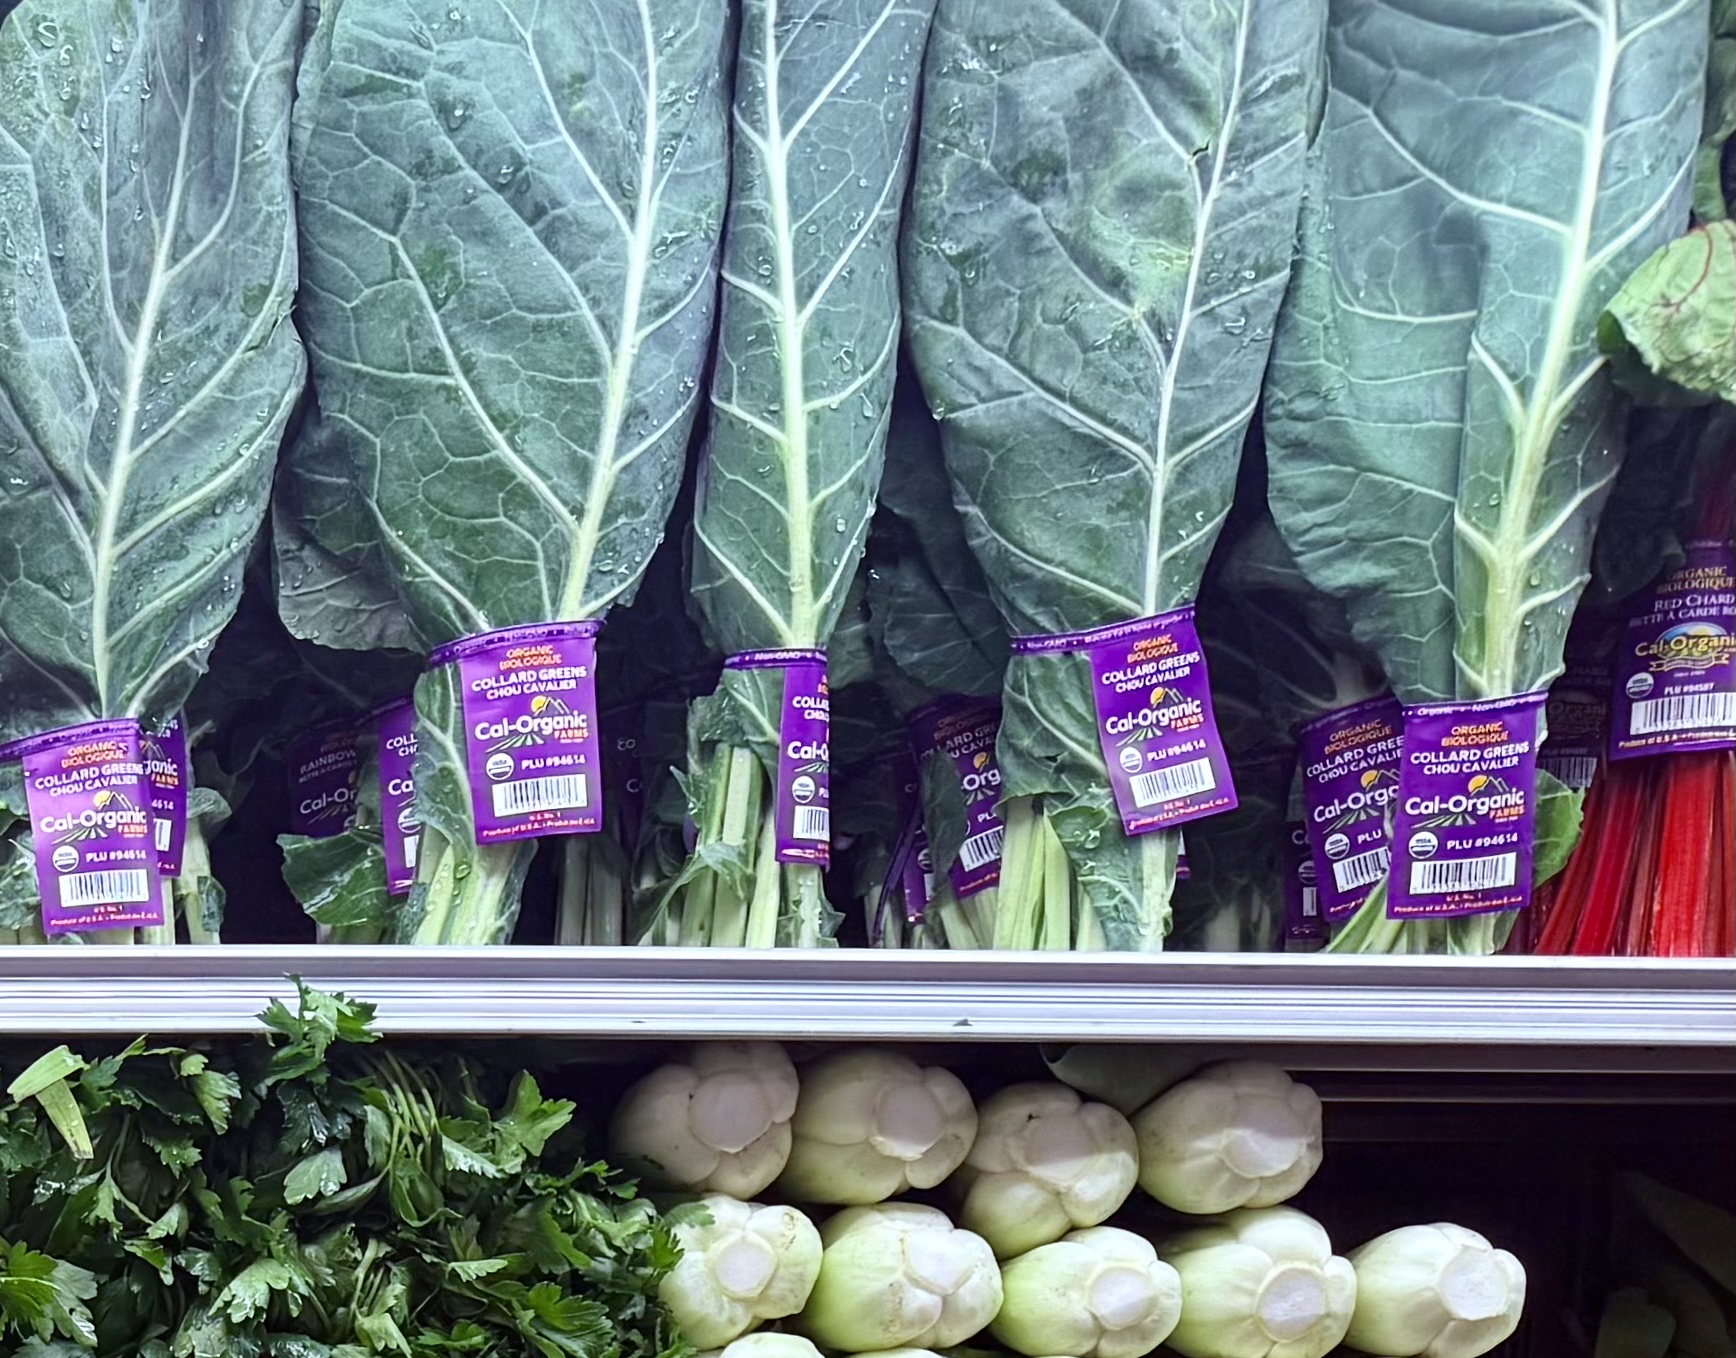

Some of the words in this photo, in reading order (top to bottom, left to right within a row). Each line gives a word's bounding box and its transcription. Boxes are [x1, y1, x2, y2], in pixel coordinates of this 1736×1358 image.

[1654, 599, 1682, 613] RED
[1686, 594, 1735, 607] CHARD
[506, 645, 553, 658] ORGANIC
[1133, 634, 1172, 651] ORGANIC
[1635, 632, 1736, 657] Cal-Organi
[1102, 662, 1156, 685] COLLARD
[1158, 651, 1200, 671] GREENS
[472, 669, 537, 691] COLLARD
[539, 666, 587, 680] GREENS
[1116, 679, 1144, 693] CHOU
[1145, 667, 1190, 686] CAVALIER
[487, 686, 521, 700] CHOU
[523, 680, 576, 694] CAVALIER
[475, 710, 587, 740] Cal-Organic
[1106, 697, 1202, 734] Cal-Organic
[554, 729, 589, 739] FARMS
[1329, 719, 1382, 742] ORGANIC
[1441, 731, 1509, 747] BIOLOGIQUE
[1451, 722, 1503, 736] ORGANIC
[1147, 750, 1167, 762] PLU
[1411, 749, 1480, 764] COLLARD
[1483, 742, 1529, 758] GREENS
[522, 758, 543, 770] PLU
[1306, 751, 1364, 777] COLLARD
[1423, 763, 1459, 775] CHOU
[1464, 757, 1519, 773] CAVALIER
[35, 768, 100, 789] COLLARD
[50, 783, 84, 797] CHOU
[86, 775, 138, 791] CAVALIER
[1405, 788, 1525, 815] Cal-Organic
[40, 806, 147, 833] Cal-Organic
[1490, 807, 1524, 819] FARMS
[1358, 830, 1381, 844] PLU
[1447, 839, 1472, 850] PLU
[86, 851, 107, 862] PLU
